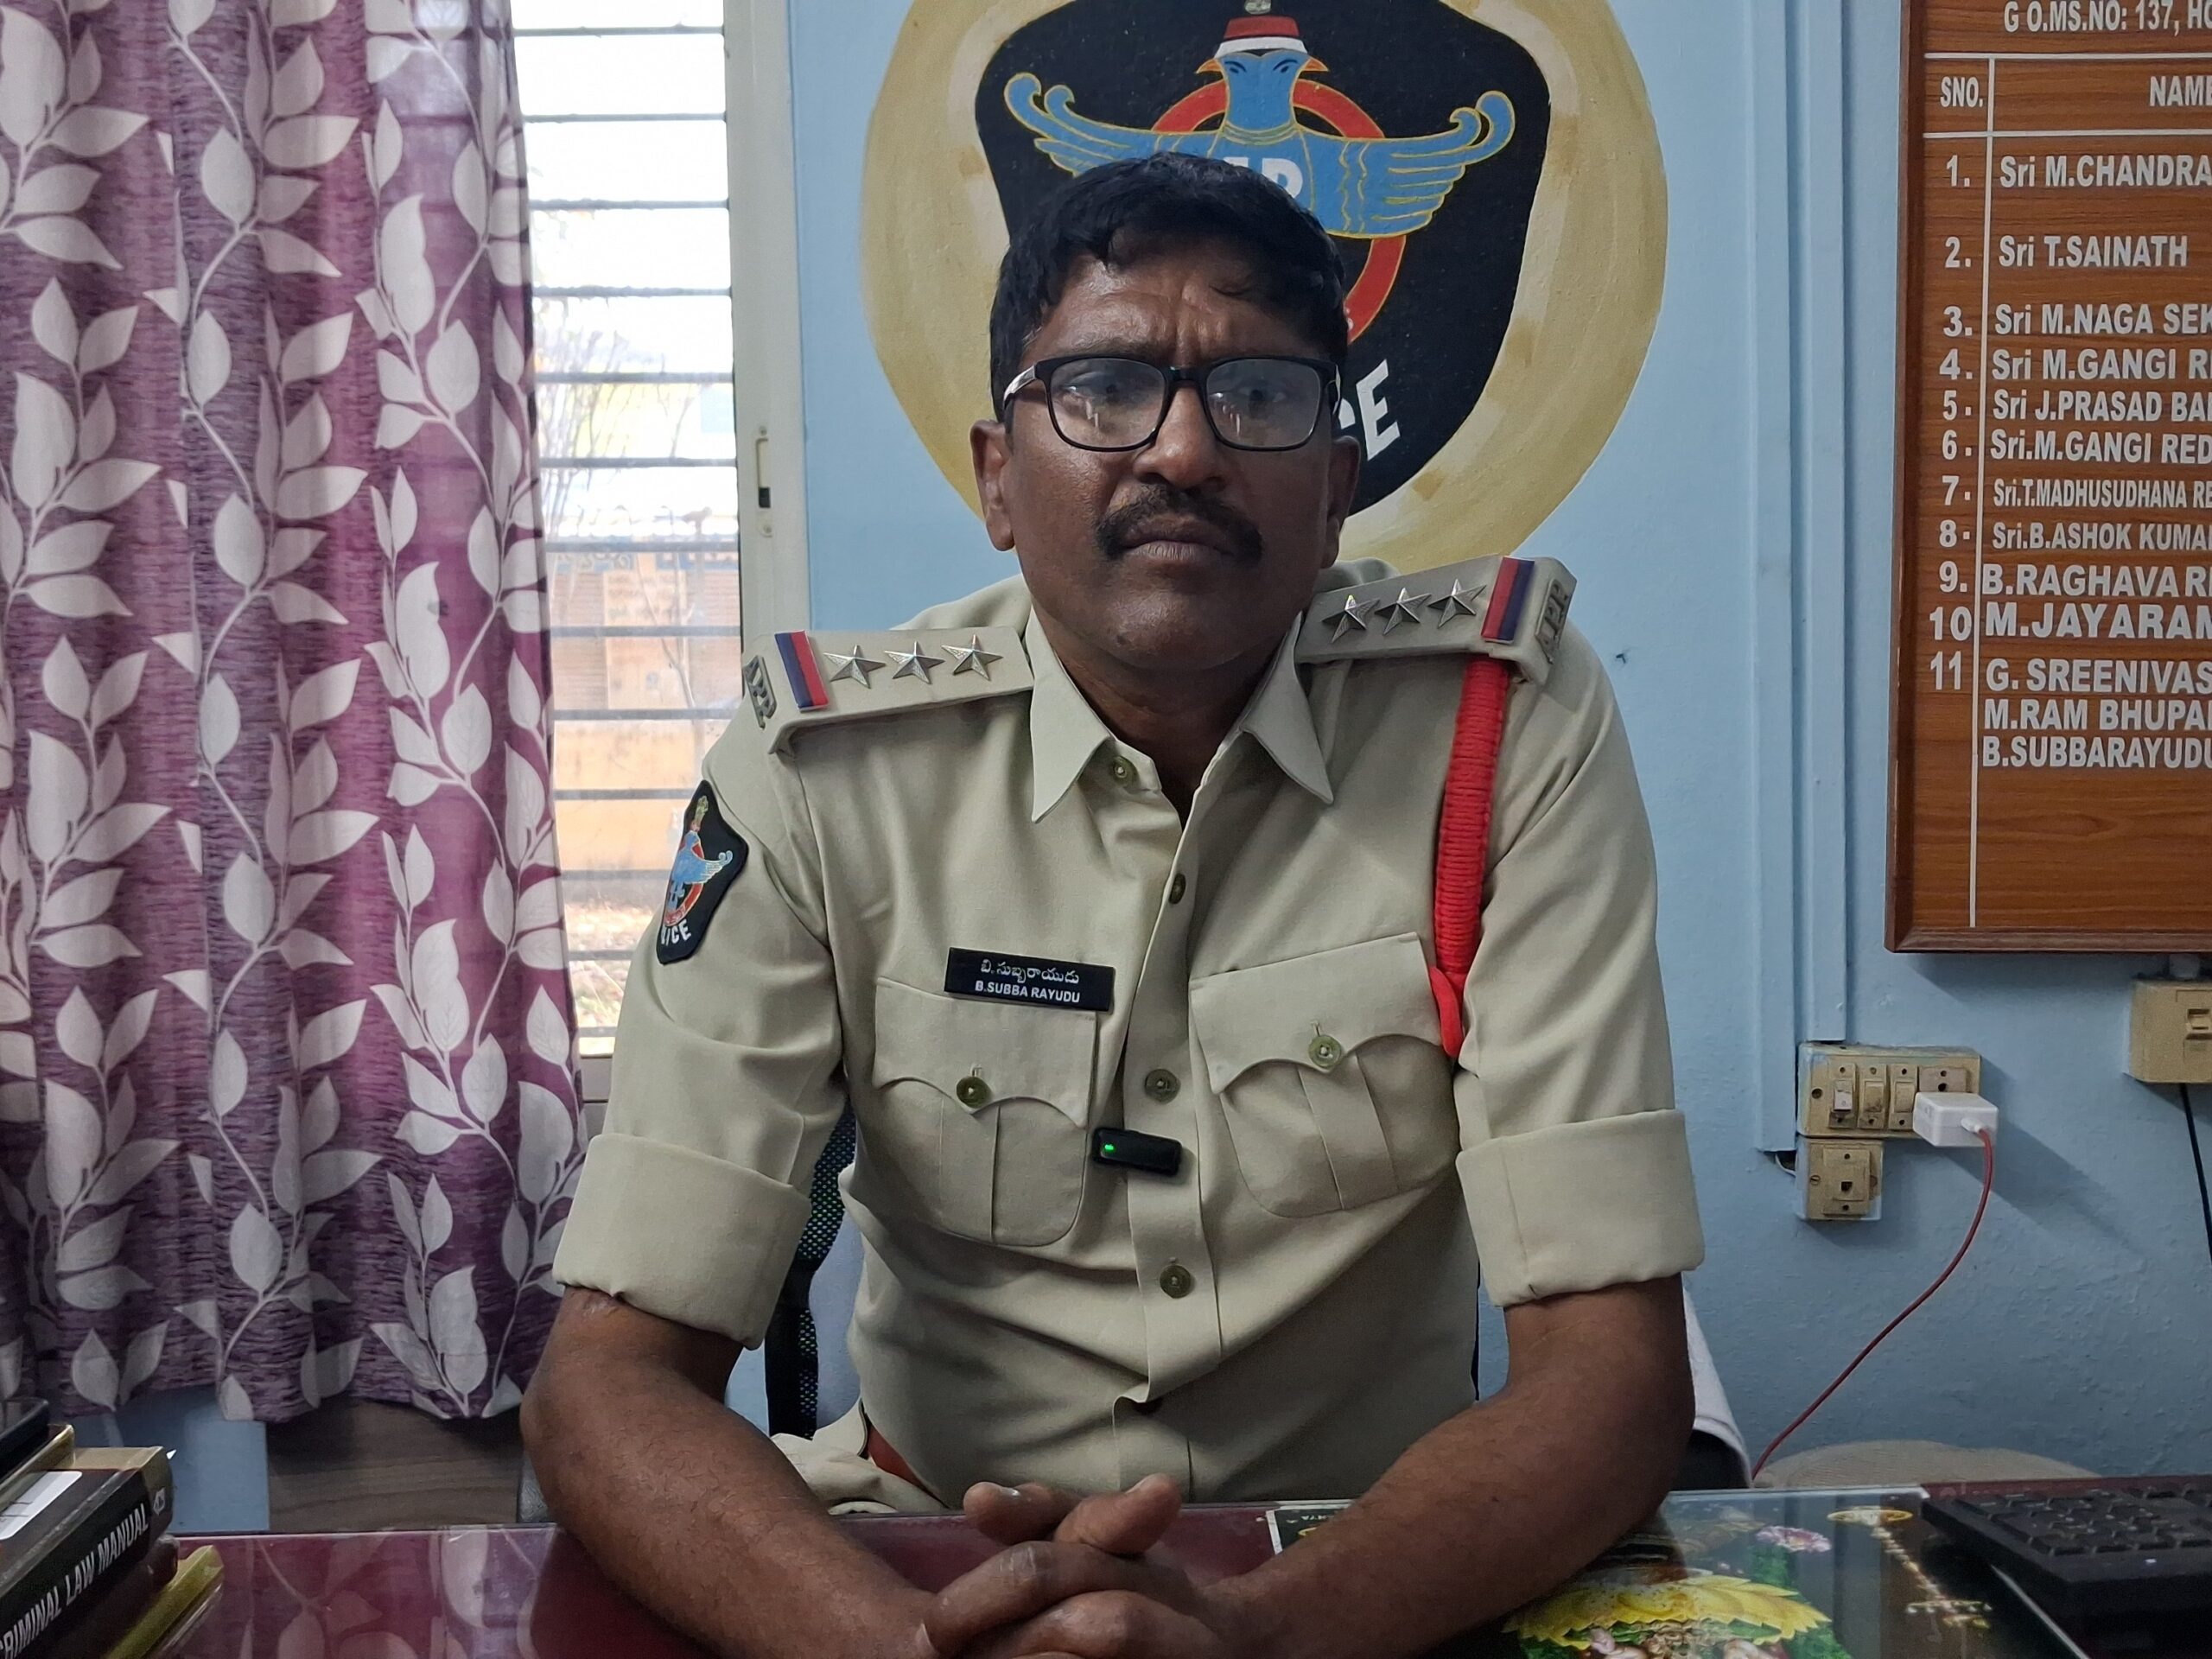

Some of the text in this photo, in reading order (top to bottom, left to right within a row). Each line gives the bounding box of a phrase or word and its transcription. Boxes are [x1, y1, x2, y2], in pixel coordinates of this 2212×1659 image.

[2135, 0, 2179, 35] 137,
[1940, 76, 1983, 107] SNO.
[1946, 155, 2212, 188] 1. Sri M.CHANDRA
[1945, 235, 2188, 268] 2. Sri T.SAINATH
[1943, 306, 1973, 337] 3.
[1994, 304, 2031, 334] Sri
[2041, 304, 2153, 334] M.NAGA
[1939, 348, 2212, 380] 4. Sri M.GANGI R
[1942, 389, 2212, 422] 5. Sri J.PRASAD BA
[1942, 429, 2212, 464] 6. Sri.M.GANGI RED
[1942, 475, 1971, 506] 7.
[1993, 478, 2188, 508] Sri.T.MADHUSUDHANA
[1939, 519, 2212, 550] 8. Sri.B.ASHOK KUMA
[1939, 561, 1968, 593] 9.
[2185, 566, 2212, 597] R
[1929, 607, 1972, 640] 10
[1930, 651, 2212, 694] 11 G. SREENIVAS
[1984, 699, 2212, 731] M.RAM BHUPA
[975, 980, 1080, 1003] B.SUBBA RAYUDU
[65, 1550, 95, 1606] LAW
[98, 1503, 149, 1575] MANUAL
